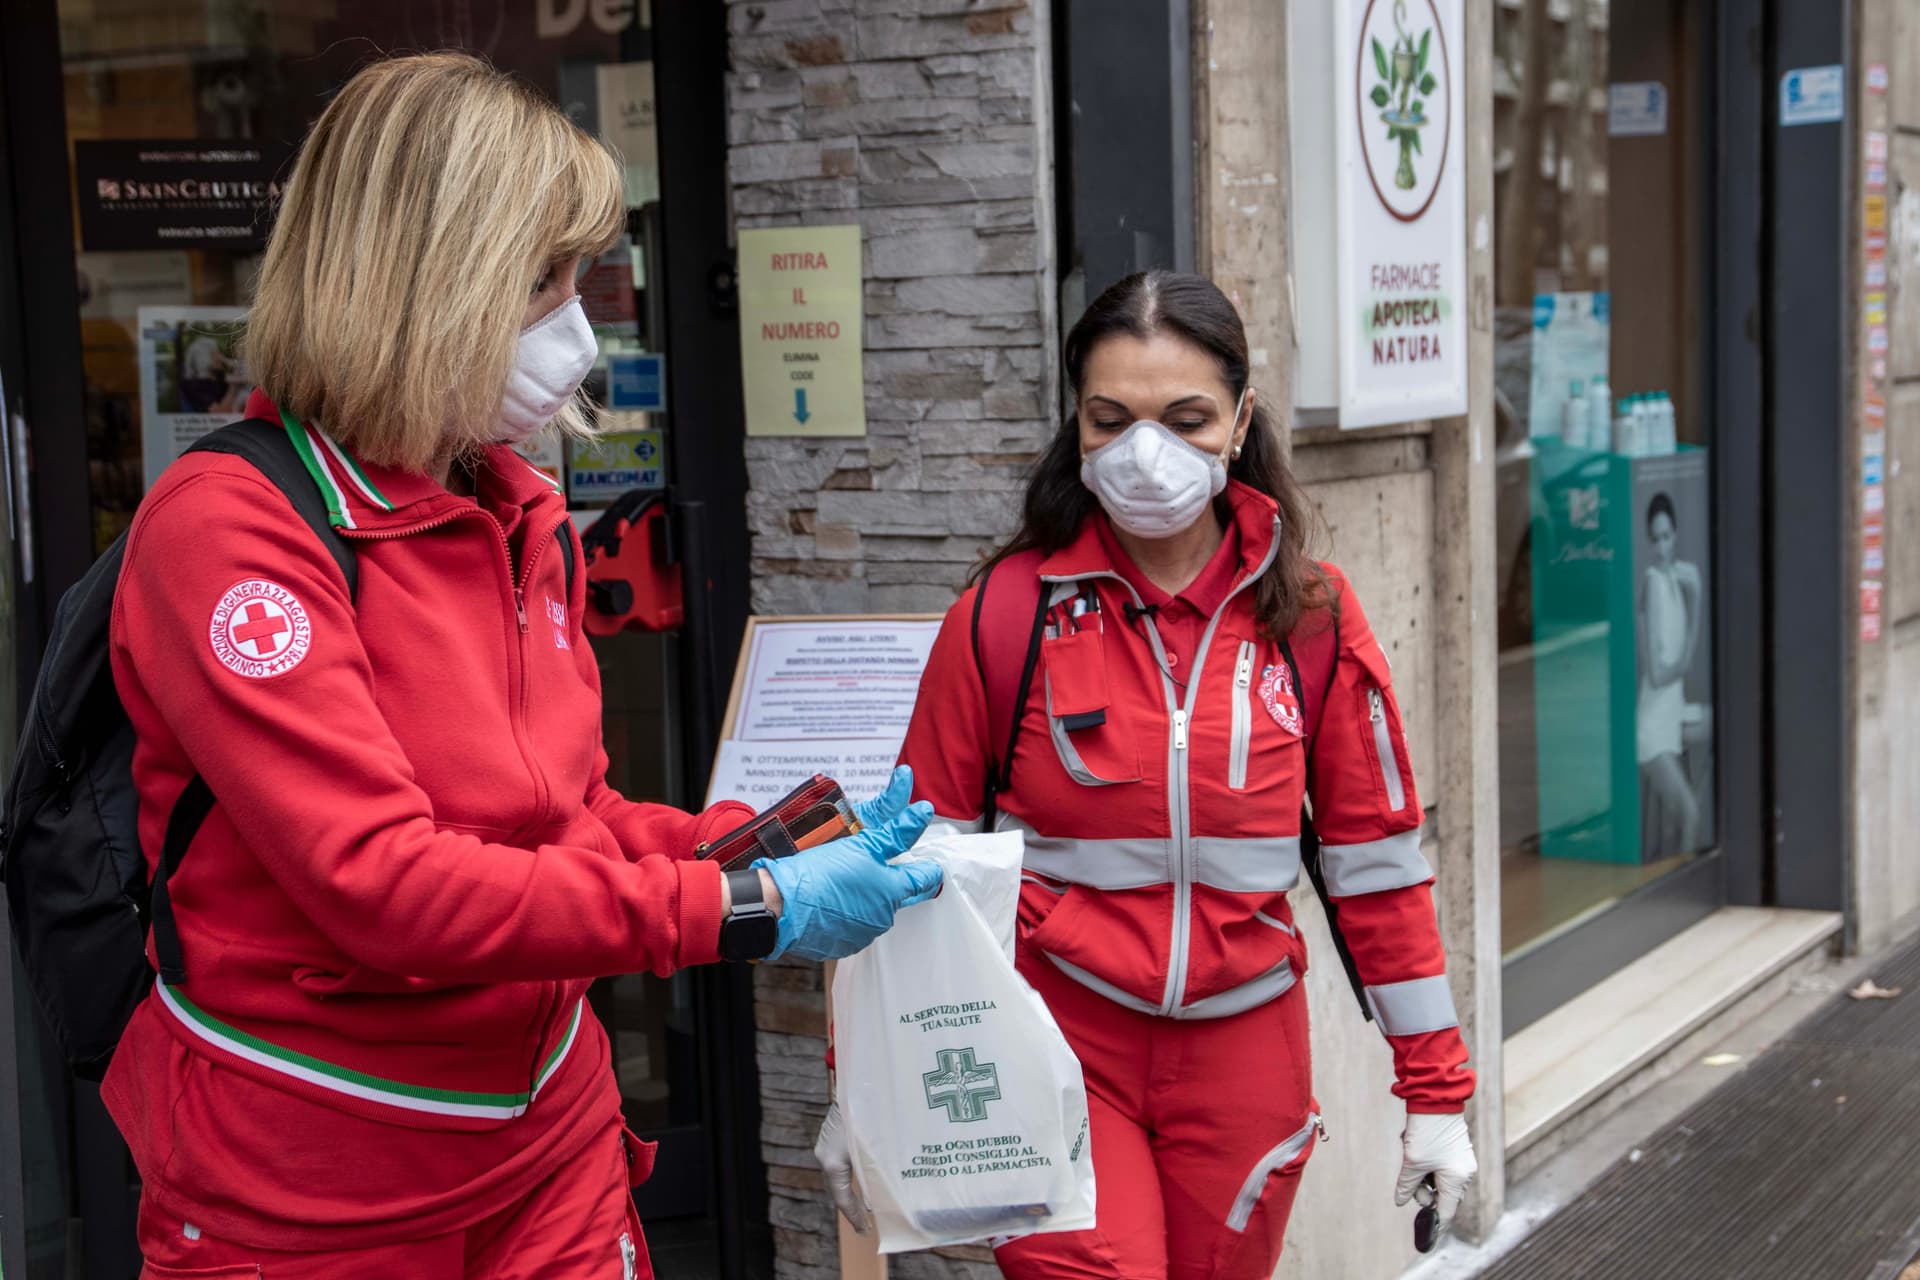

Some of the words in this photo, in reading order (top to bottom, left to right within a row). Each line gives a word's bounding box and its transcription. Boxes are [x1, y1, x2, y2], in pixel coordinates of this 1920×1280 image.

[771, 251, 828, 271] RITIRA
[1371, 263, 1441, 290] FARMACIE
[792, 287, 807, 305] IL
[1372, 299, 1441, 328] APOTECA
[761, 321, 841, 341] NUMERO
[783, 352, 820, 363] ELIMINA
[1372, 334, 1442, 364] NATURA
[790, 370, 814, 381] CODE
[573, 440, 630, 466] Pago
[574, 470, 657, 485] BANCOMAT
[223, 583, 271, 609] GINEVRA
[271, 587, 288, 601] 22
[216, 605, 231, 619] DI
[284, 599, 309, 648] AGOSTO
[212, 619, 265, 676] CONVENZIONE
[741, 755, 752, 764] IN
[757, 755, 840, 764] OTTEMPERANZA
[844, 755, 856, 763] AL
[859, 754, 897, 763] DECRET
[859, 768, 892, 776] MARZ
[735, 784, 746, 792] IN
[751, 784, 780, 793] CASO
[844, 784, 886, 792] AFFLUEN
[899, 1014, 913, 1024] AL
[913, 1005, 960, 1022] SERVIZIO
[961, 1000, 997, 1013] DELLA
[920, 1020, 943, 1033] TUA
[943, 1014, 982, 1028] SALUTE
[921, 1143, 943, 1154] PER
[945, 1139, 975, 1151] OGNI
[977, 1135, 1022, 1148] DUBBIO
[912, 1154, 952, 1166] CHIEDI
[955, 1148, 1019, 1162] CONSIGLIO
[1021, 1145, 1037, 1156] AL
[901, 1167, 947, 1180] MEDICO
[949, 1165, 959, 1175] O
[961, 1164, 977, 1175] AL
[978, 1156, 1053, 1173] FARMACISTA
